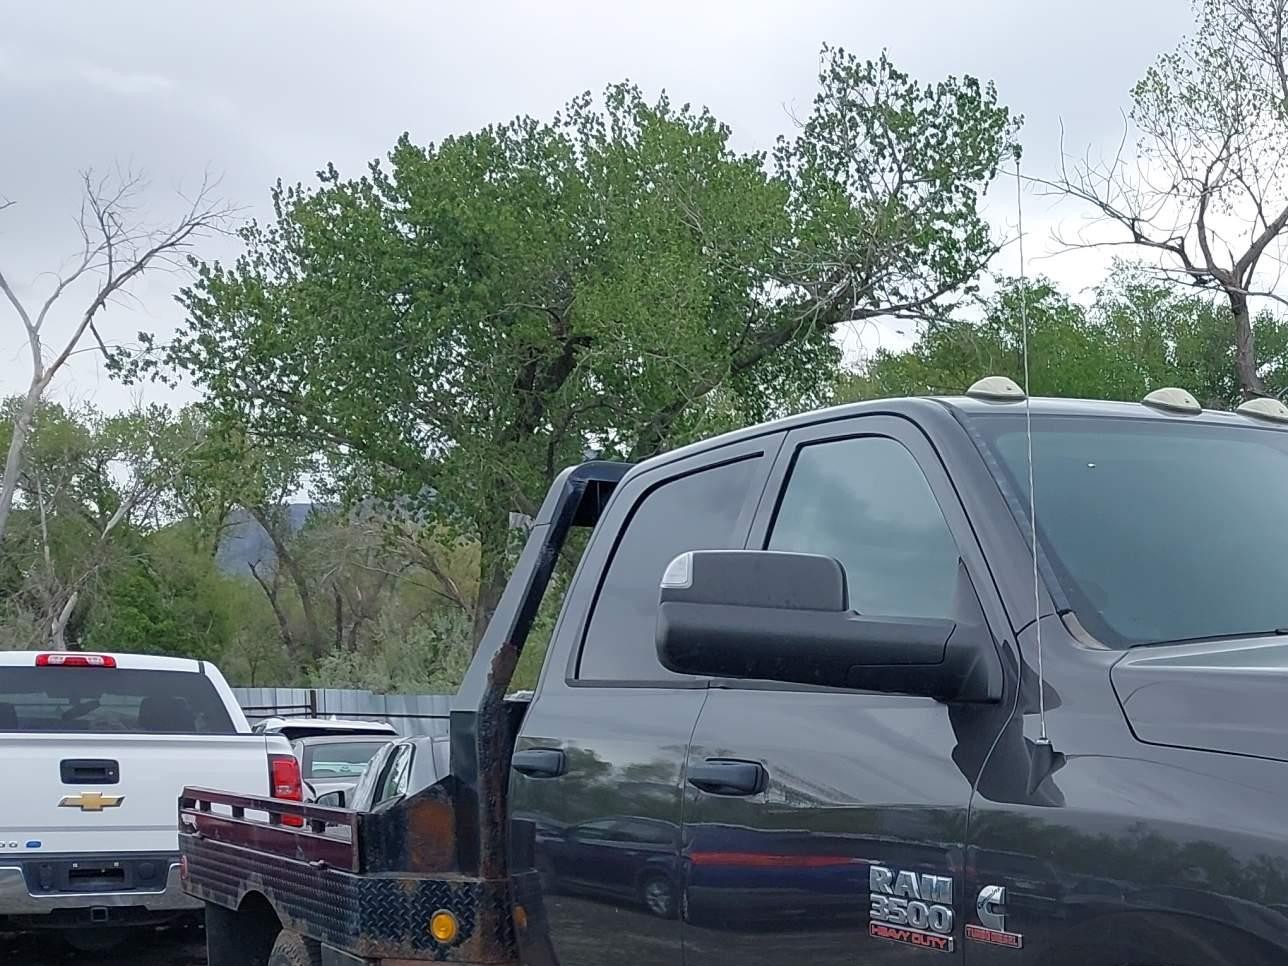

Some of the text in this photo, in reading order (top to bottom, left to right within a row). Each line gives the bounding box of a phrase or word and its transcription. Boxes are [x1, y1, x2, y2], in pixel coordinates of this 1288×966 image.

[870, 865, 953, 905] RAM
[870, 893, 953, 934] 3500
[871, 924, 947, 950] HEAVY DUTY
